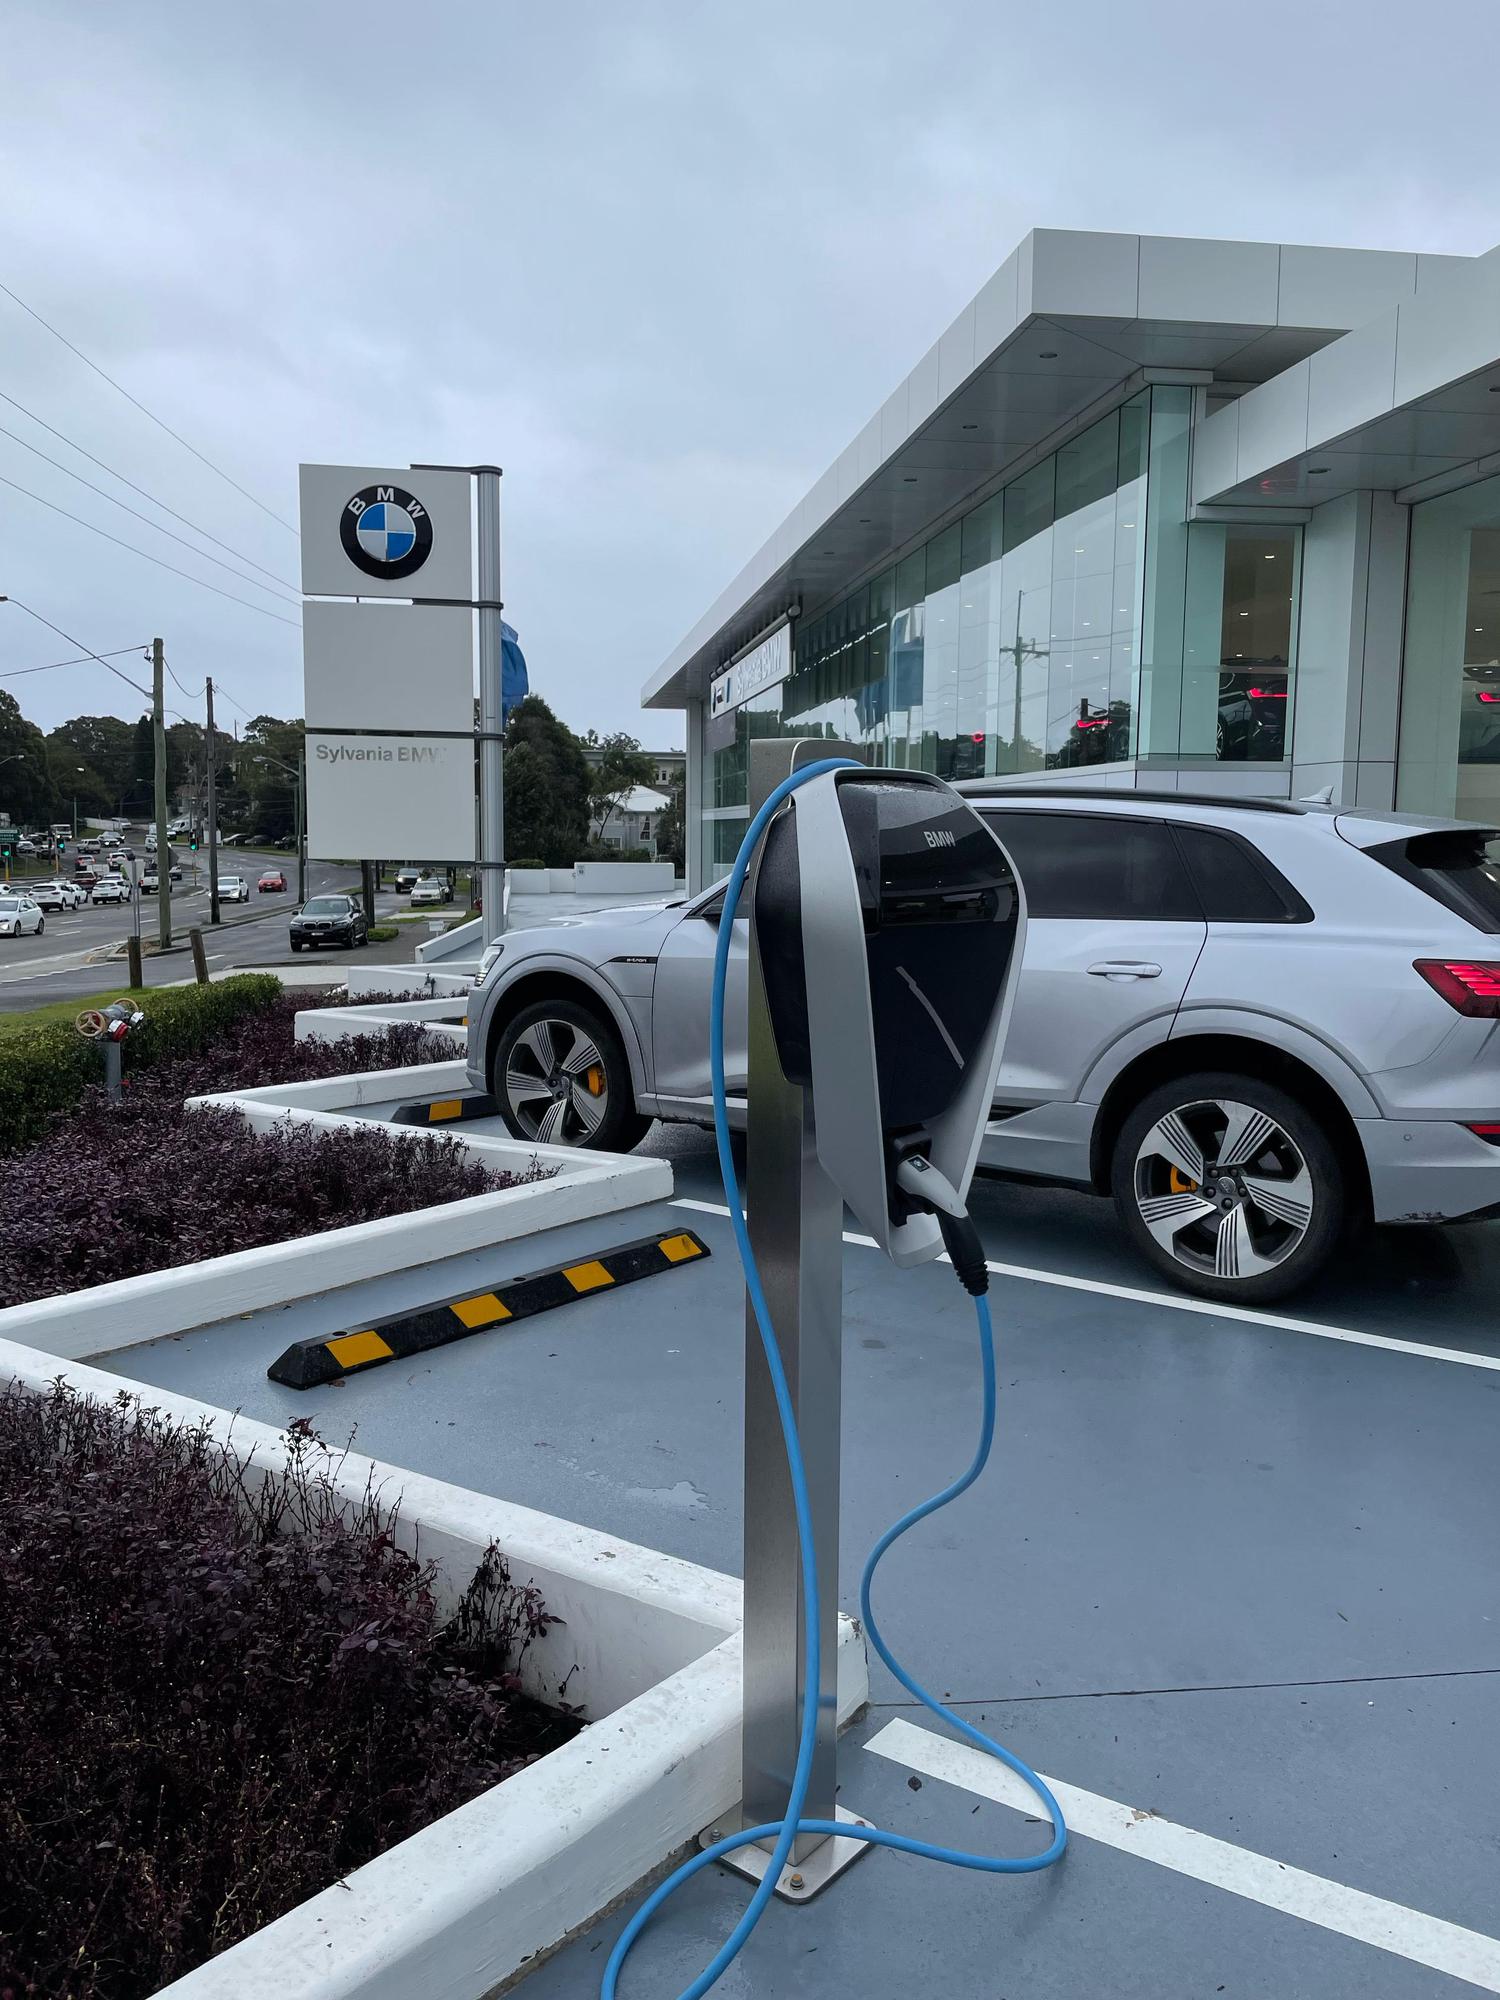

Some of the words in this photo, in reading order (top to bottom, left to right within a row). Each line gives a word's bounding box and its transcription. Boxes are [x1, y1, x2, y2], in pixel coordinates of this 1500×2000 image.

[347, 487, 425, 519] BMW
[316, 744, 393, 763] Sylvania
[923, 831, 956, 847] BMW
